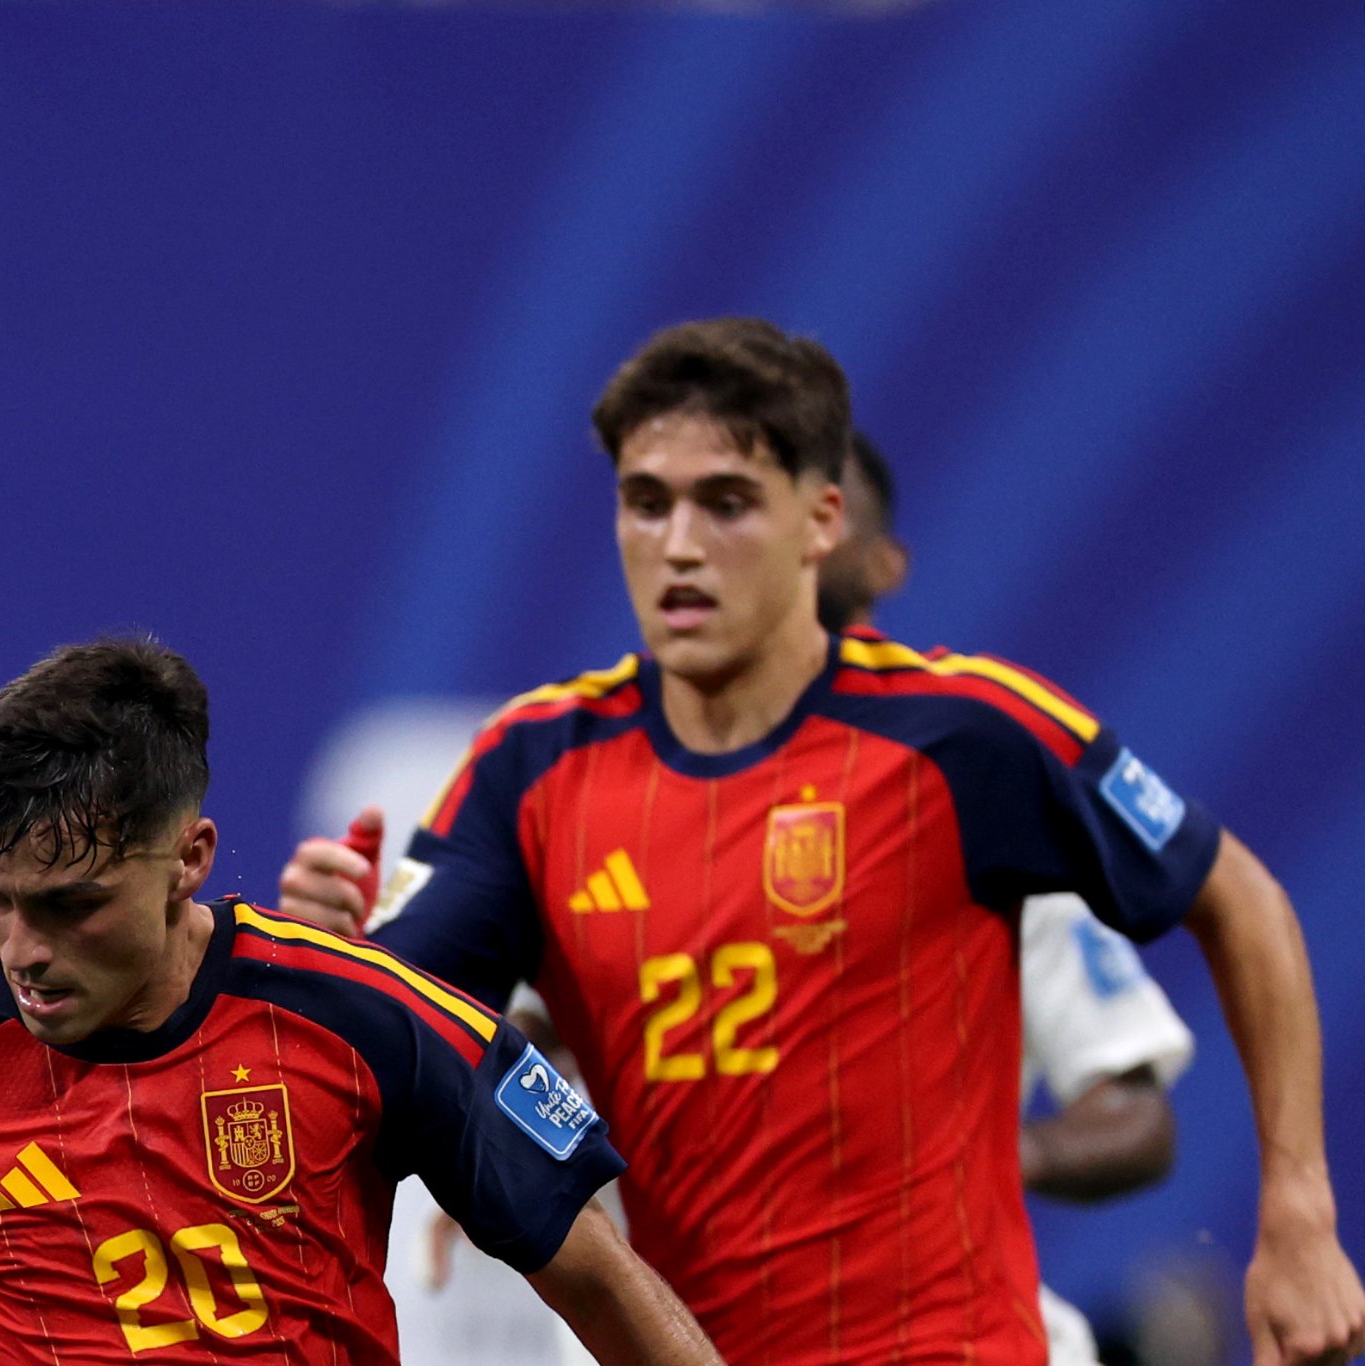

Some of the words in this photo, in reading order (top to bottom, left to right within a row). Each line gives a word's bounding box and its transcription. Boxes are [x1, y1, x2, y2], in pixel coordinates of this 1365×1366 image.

[639, 942, 778, 1081] 22
[568, 1108, 589, 1130] FIFA
[91, 1222, 269, 1353] 20
